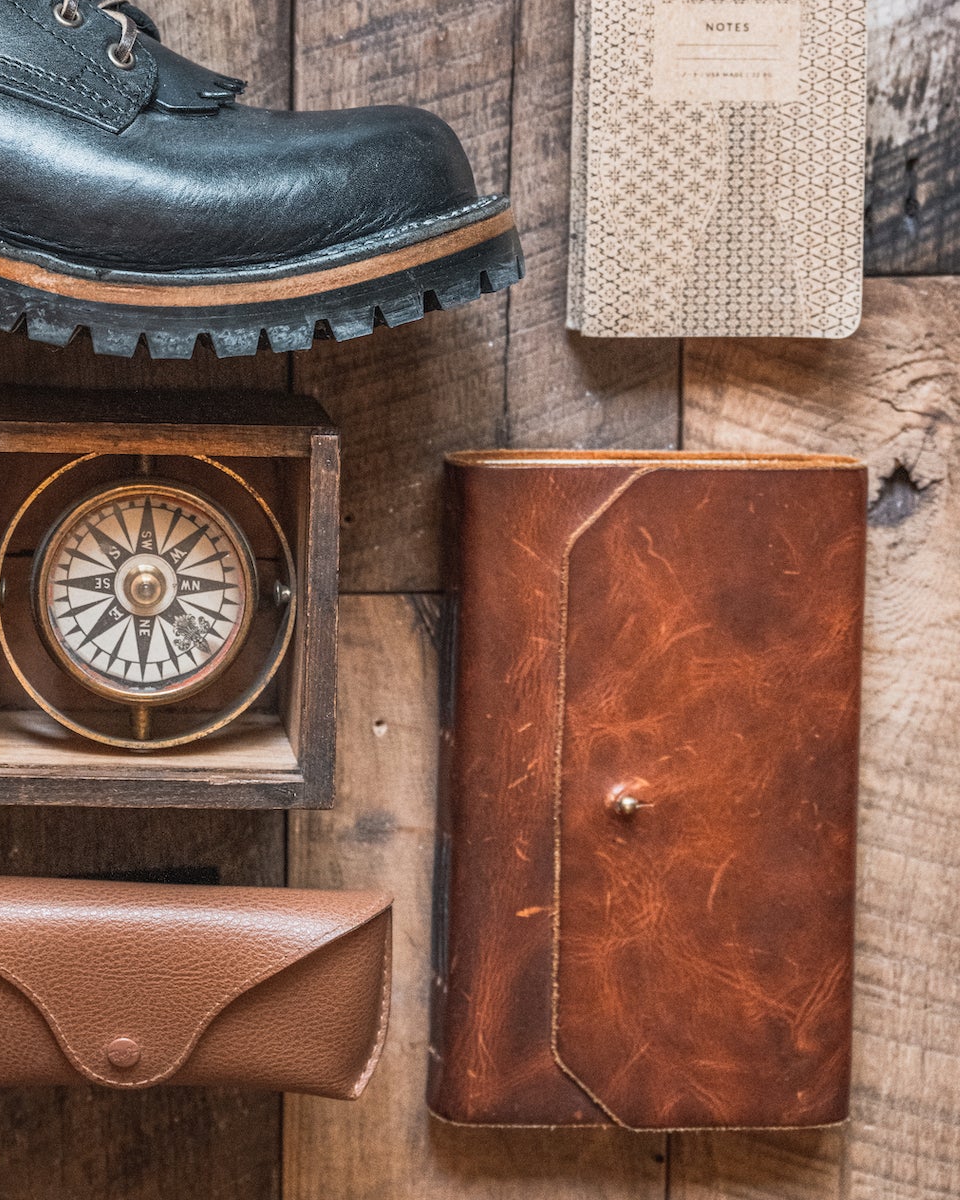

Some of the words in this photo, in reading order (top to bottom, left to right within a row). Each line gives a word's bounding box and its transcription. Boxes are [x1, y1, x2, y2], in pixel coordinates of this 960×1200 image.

[705, 22, 750, 33] NOTES
[141, 530, 154, 551] SW
[108, 545, 121, 560] S
[169, 547, 188, 564] W
[94, 577, 111, 590] SE
[180, 580, 201, 591] NW
[108, 606, 125, 621] E
[138, 619, 151, 638] NE
